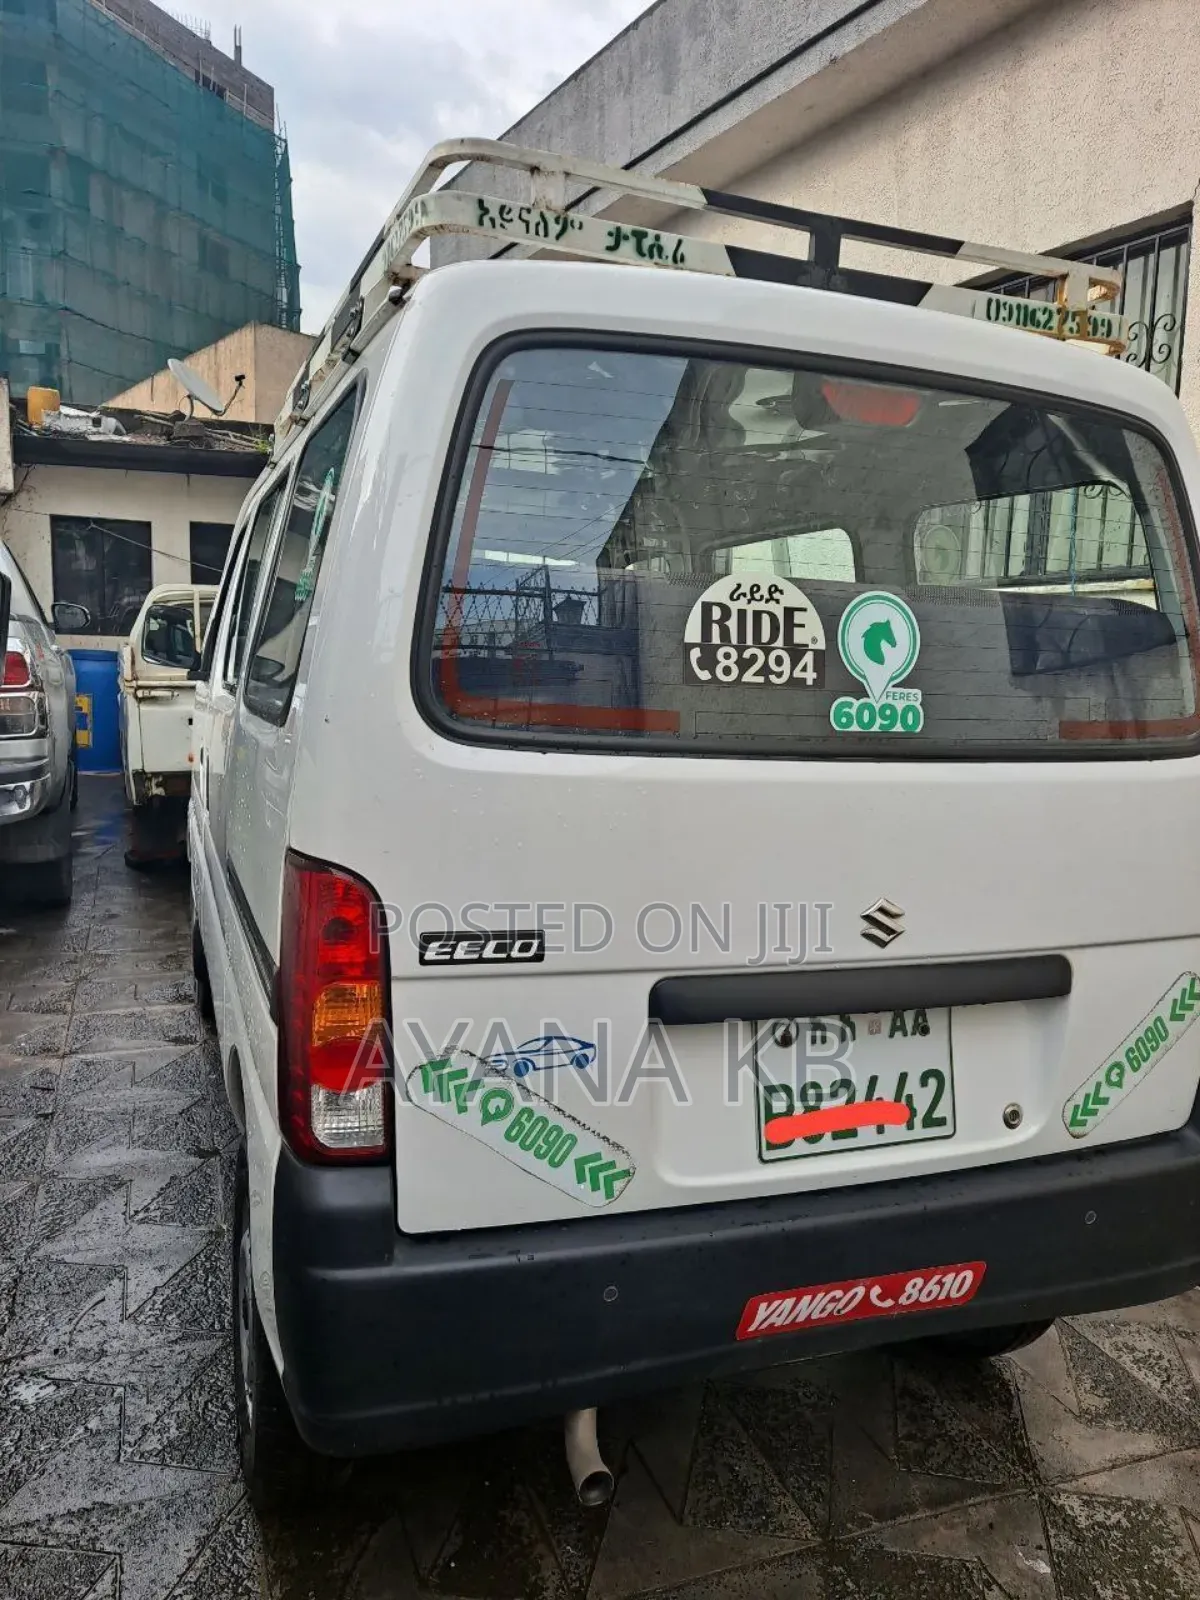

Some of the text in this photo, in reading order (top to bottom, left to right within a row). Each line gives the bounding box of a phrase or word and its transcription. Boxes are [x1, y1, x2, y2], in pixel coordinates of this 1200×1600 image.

[729, 583, 784, 604] ራይድ
[701, 601, 809, 647] RIDE
[715, 646, 817, 686] 8294
[833, 701, 920, 731] 6090
[885, 690, 919, 702] FERES
[423, 938, 541, 961] EECO
[1125, 1015, 1169, 1073] 6090
[504, 1107, 578, 1168] 6090
[746, 1270, 974, 1332] YANGO 8610
